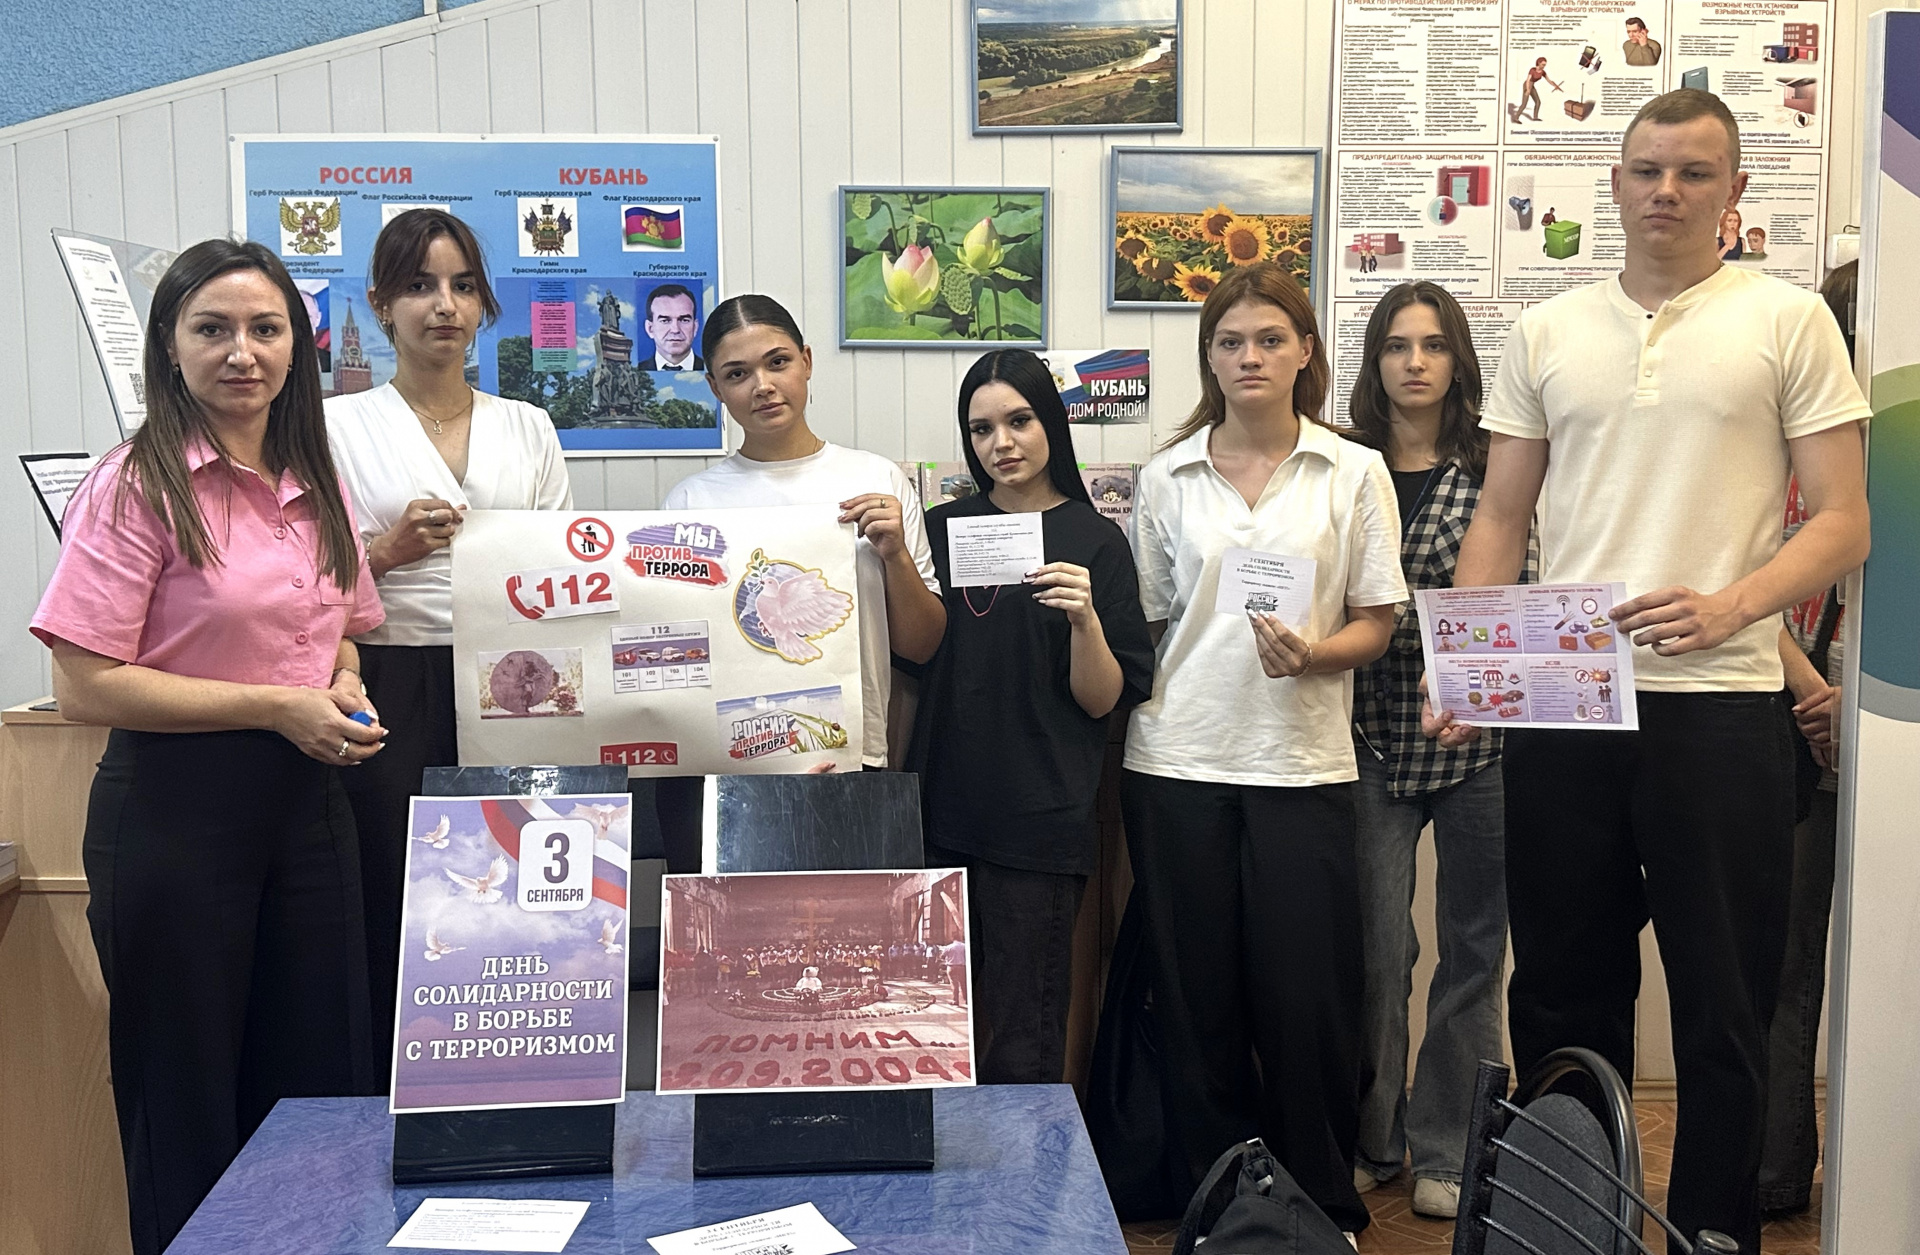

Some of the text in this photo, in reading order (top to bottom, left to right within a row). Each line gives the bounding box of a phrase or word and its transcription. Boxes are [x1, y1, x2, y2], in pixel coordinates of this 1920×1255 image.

[320, 167, 412, 184] РОССИЯ
[559, 168, 648, 185] КУБАНЬ
[314, 189, 358, 198] Федерации
[382, 193, 427, 201] Российской
[428, 194, 473, 202] Федерации
[623, 195, 688, 203] Краснодарского
[633, 270, 693, 278] Краснодарского
[1090, 379, 1147, 397] КУБАНЬ
[1068, 400, 1146, 419] ДОМ РОДНОЙ!
[674, 523, 717, 549] МЫ
[632, 545, 692, 561] ПРОТИВ
[645, 561, 710, 578] ТЕРРОРА
[536, 572, 613, 608] 112
[650, 626, 670, 635] 112
[733, 714, 789, 740] РОССИЯ
[735, 730, 773, 751] ПРОТИВ
[744, 735, 790, 758] ТЕРРОРА!
[617, 748, 657, 765] 112
[543, 832, 570, 884] 3
[527, 888, 584, 902] СЕНТЯБРЯ
[481, 955, 550, 979] ДЕНЬ
[413, 980, 613, 1006] СОЛИДАРНОСТИ
[452, 1008, 573, 1032] В БОРЬБЕ
[405, 1033, 616, 1061] С ТЕРРОРИЗМОМ
